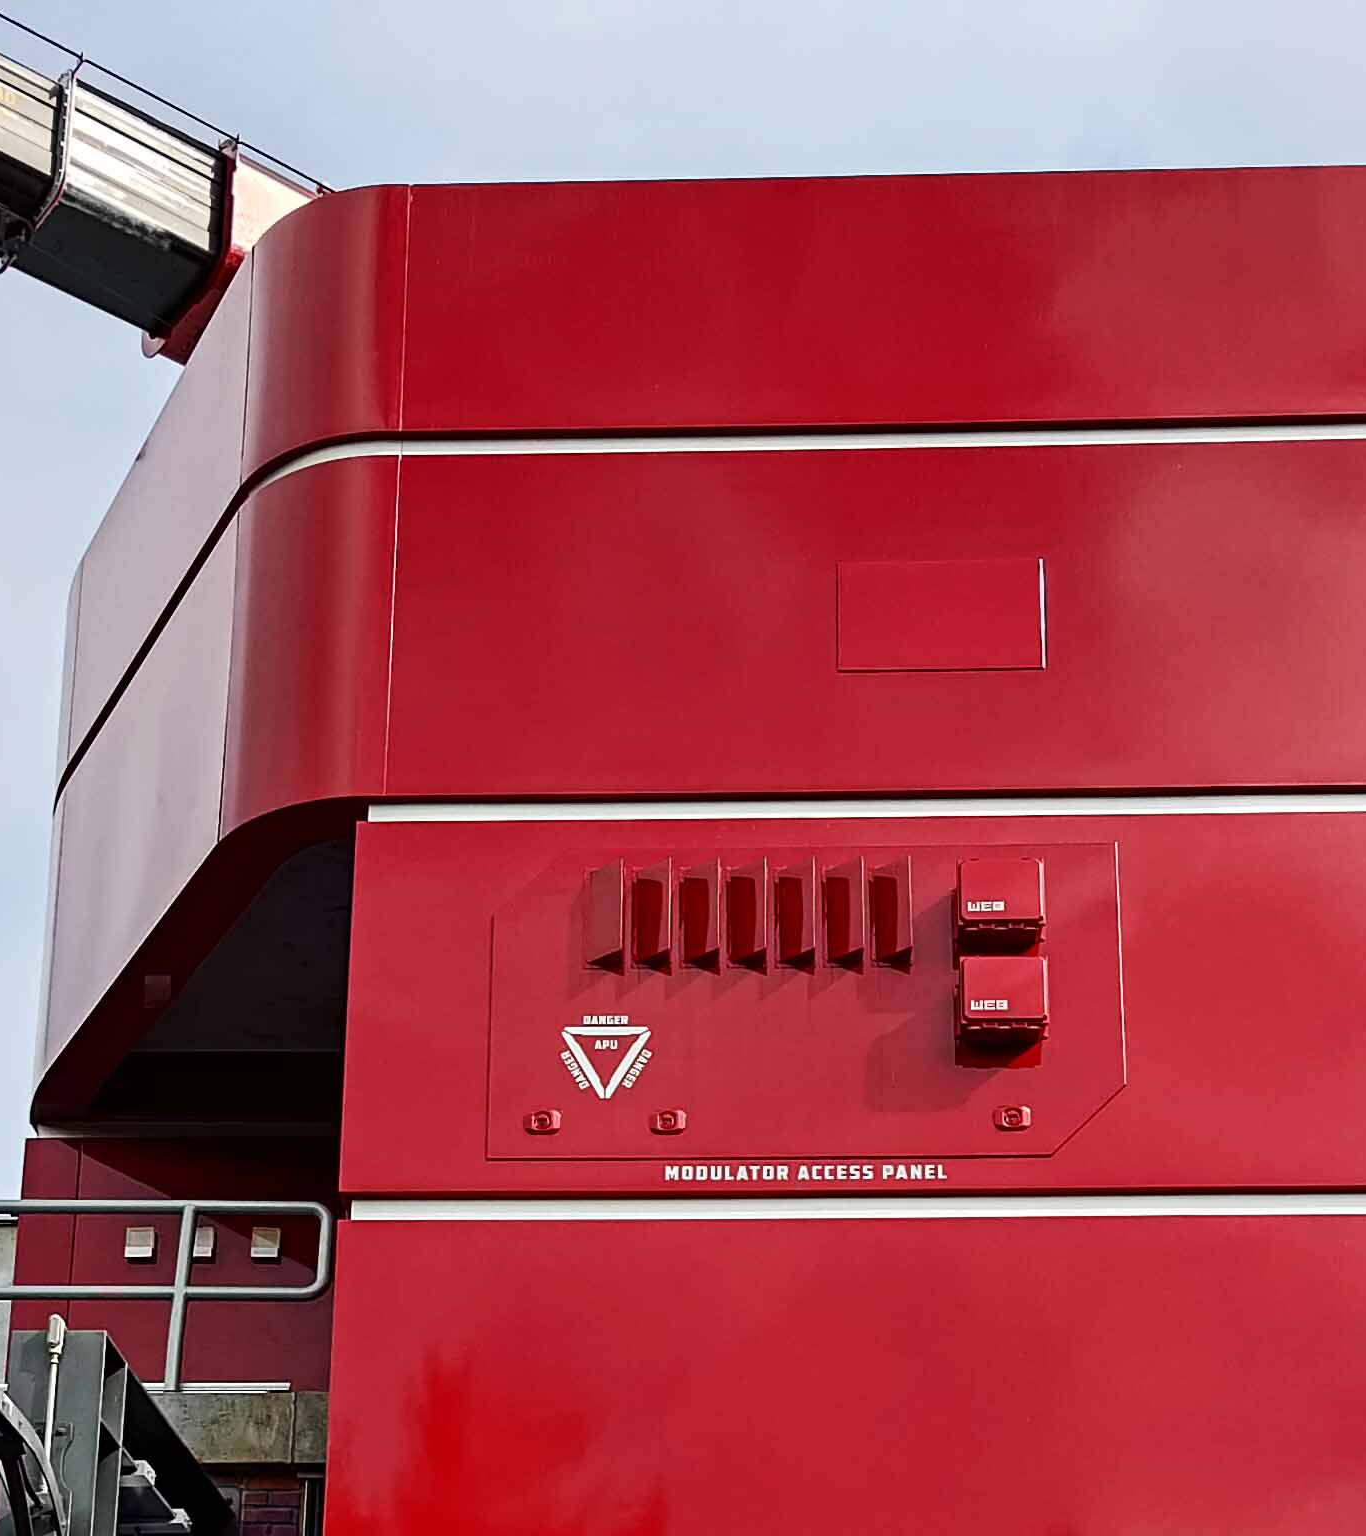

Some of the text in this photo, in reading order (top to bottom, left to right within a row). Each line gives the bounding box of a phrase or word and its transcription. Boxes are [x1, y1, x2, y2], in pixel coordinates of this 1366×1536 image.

[583, 1015, 629, 1025] DANGER
[594, 1039, 618, 1050] APU
[560, 1050, 590, 1090] DANGER
[621, 1048, 653, 1089] DANGER
[664, 1164, 948, 1181] MODULATOR ACCESS PANEL
